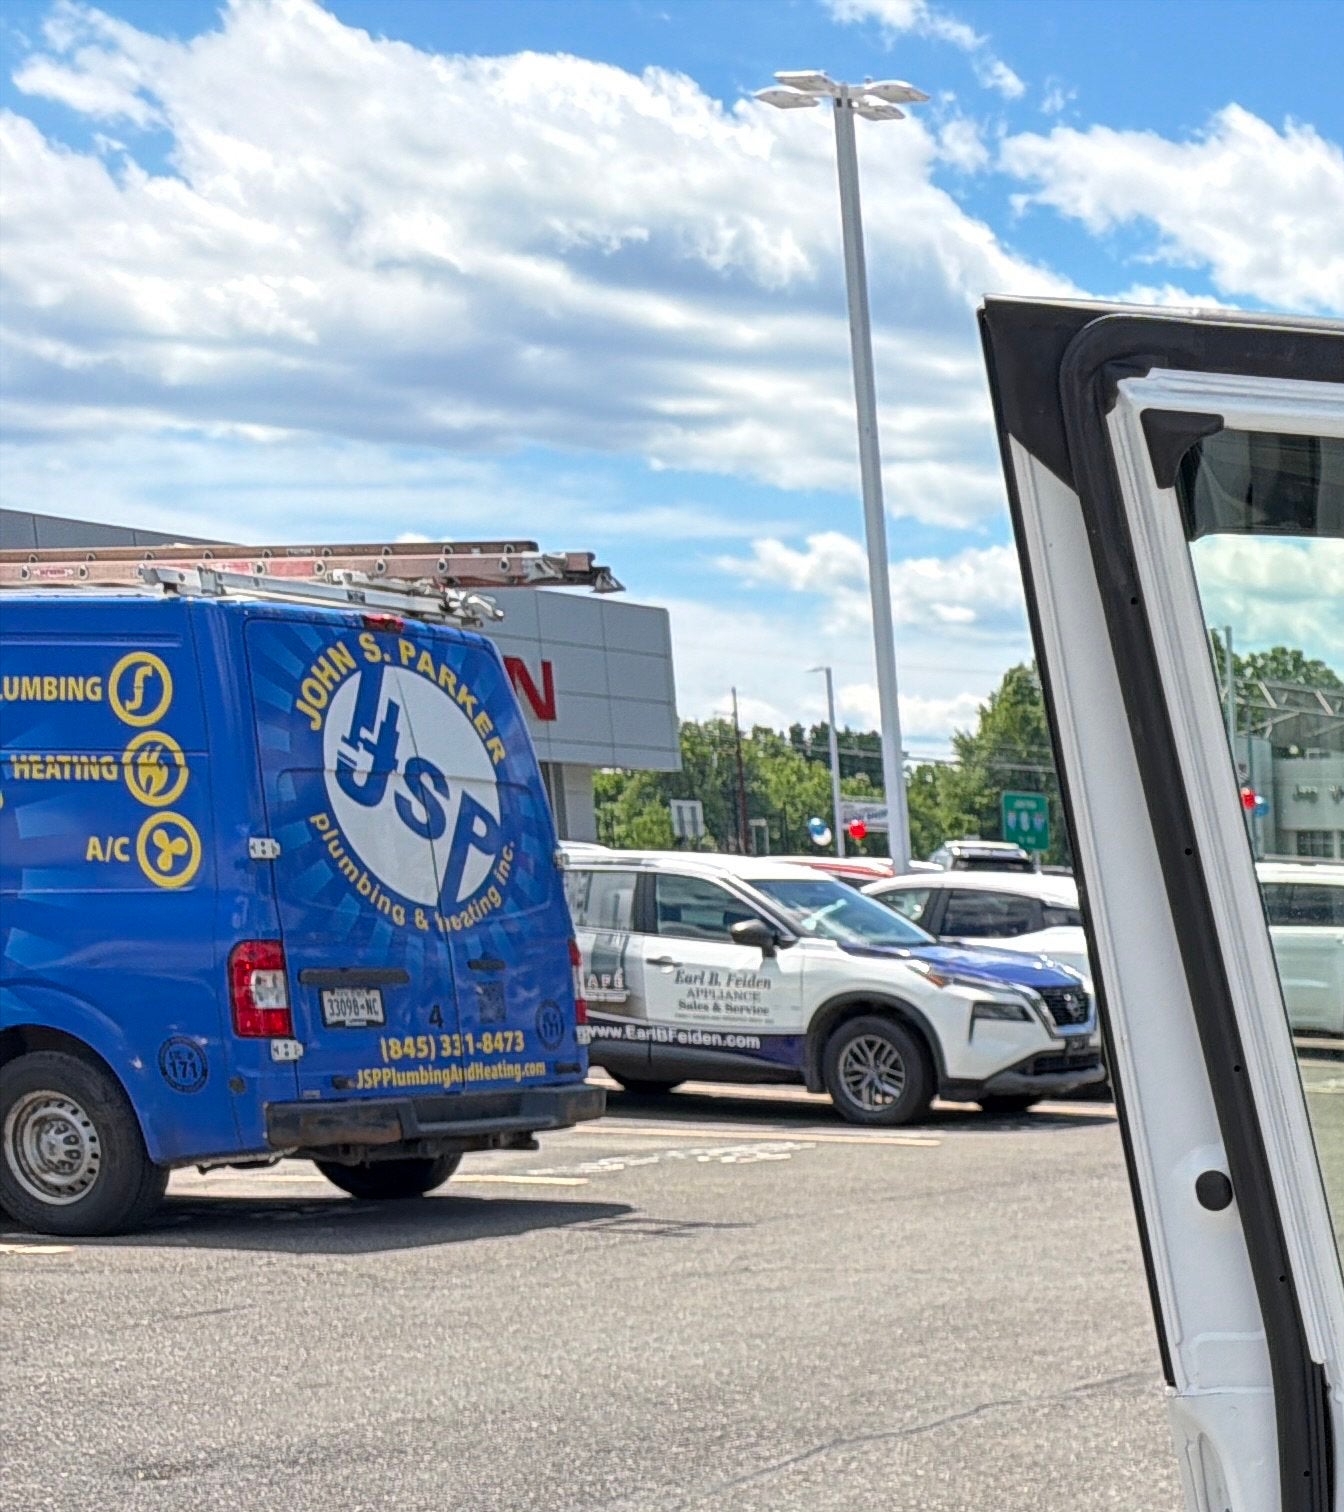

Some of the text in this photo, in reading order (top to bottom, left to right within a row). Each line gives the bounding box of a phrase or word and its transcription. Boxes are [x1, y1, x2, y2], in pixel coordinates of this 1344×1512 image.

[0, 676, 102, 701] UMBING
[296, 632, 506, 764] JOHN S. PARKER
[10, 755, 118, 781] HEATING
[86, 836, 130, 862] A/C
[310, 813, 406, 926] plumbing
[415, 911, 429, 932] &
[434, 889, 502, 933] heating
[675, 969, 704, 986] Earl
[726, 973, 771, 990] Feiden
[678, 1000, 769, 1016] Sales & Service
[686, 989, 760, 1003] APPLIANCE
[429, 1004, 443, 1028] 4
[380, 1030, 525, 1062] (845) 331-8473
[170, 1061, 197, 1078] 171
[356, 1061, 546, 1089] JSPPlumbingAndHeating.com
